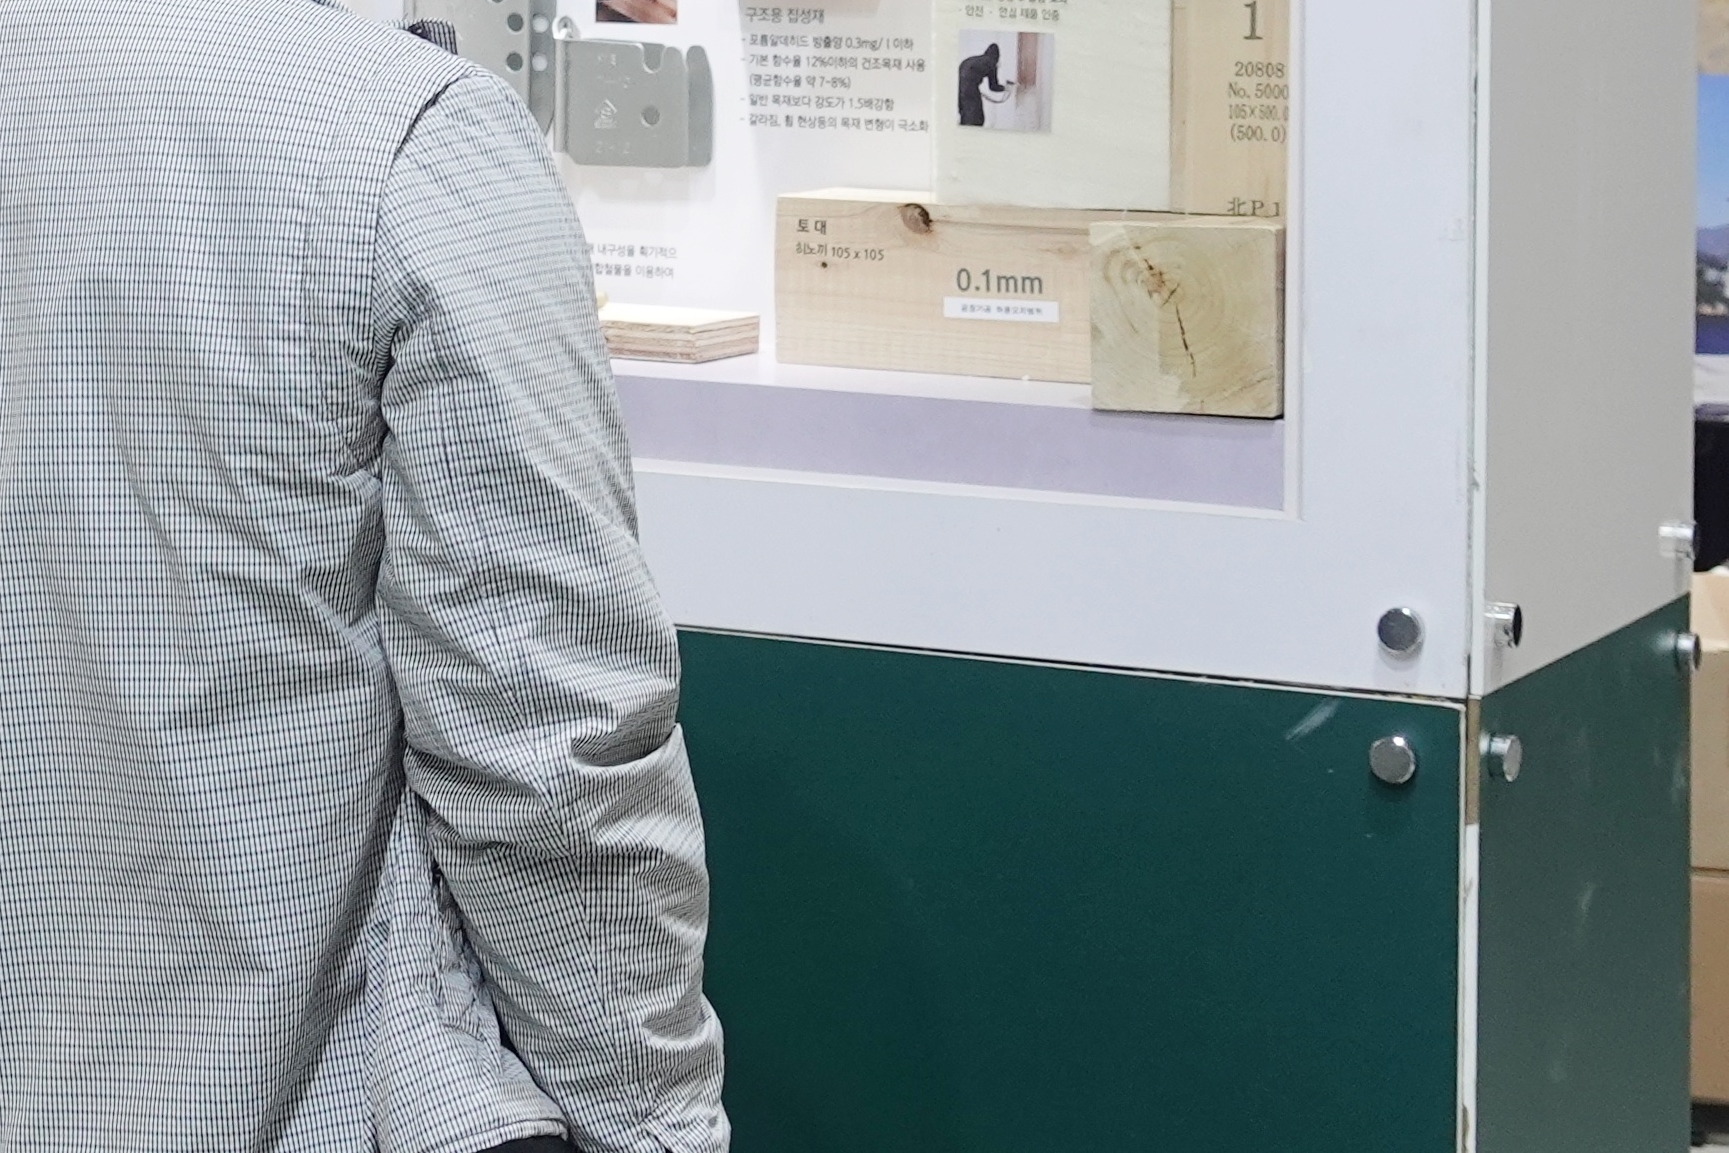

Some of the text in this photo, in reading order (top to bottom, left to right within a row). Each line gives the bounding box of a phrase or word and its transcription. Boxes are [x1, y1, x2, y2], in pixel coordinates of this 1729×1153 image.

[745, 7, 825, 24] 구조용 집성재
[749, 54, 770, 67] 기본
[772, 54, 801, 68] 함수율
[862, 56, 902, 71] 건조목재
[905, 58, 926, 72] 사용
[806, 75, 816, 88] 약
[749, 94, 769, 106] 일반
[772, 95, 811, 107] 목재보다
[815, 96, 845, 109] 강도가
[840, 116, 861, 130] 목재
[864, 118, 894, 131] 변형이
[898, 119, 929, 133] 극소화
[598, 243, 636, 257] 내구성을
[639, 244, 677, 258] 획기적으
[796, 242, 827, 256] 히노끼
[831, 247, 850, 259] 105
[865, 249, 885, 261] 105
[635, 265, 674, 279] 이용하여
[956, 268, 1043, 294] 0.1mm
